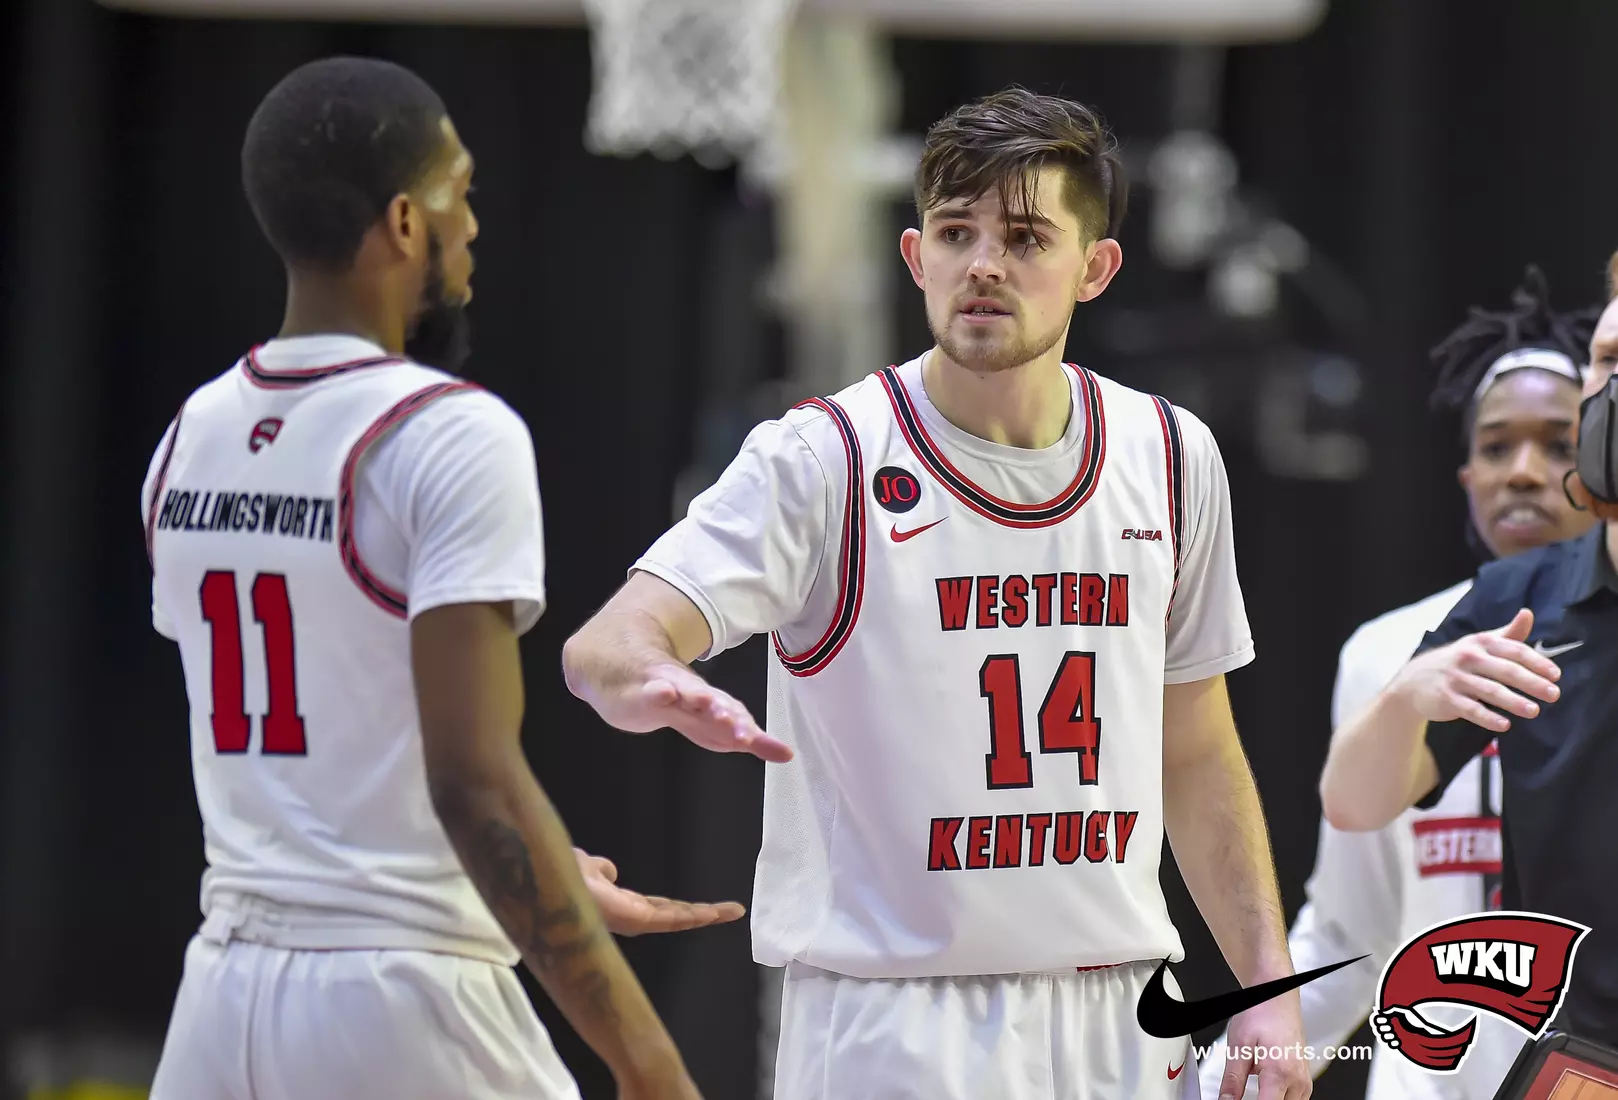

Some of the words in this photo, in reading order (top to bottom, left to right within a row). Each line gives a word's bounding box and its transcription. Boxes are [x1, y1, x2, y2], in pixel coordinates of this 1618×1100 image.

[158, 489, 335, 543] HOLLINGSWORTH
[880, 475, 918, 504] JO
[935, 572, 1130, 632] WESTERN
[198, 570, 308, 756] 11
[978, 650, 1102, 791] 14
